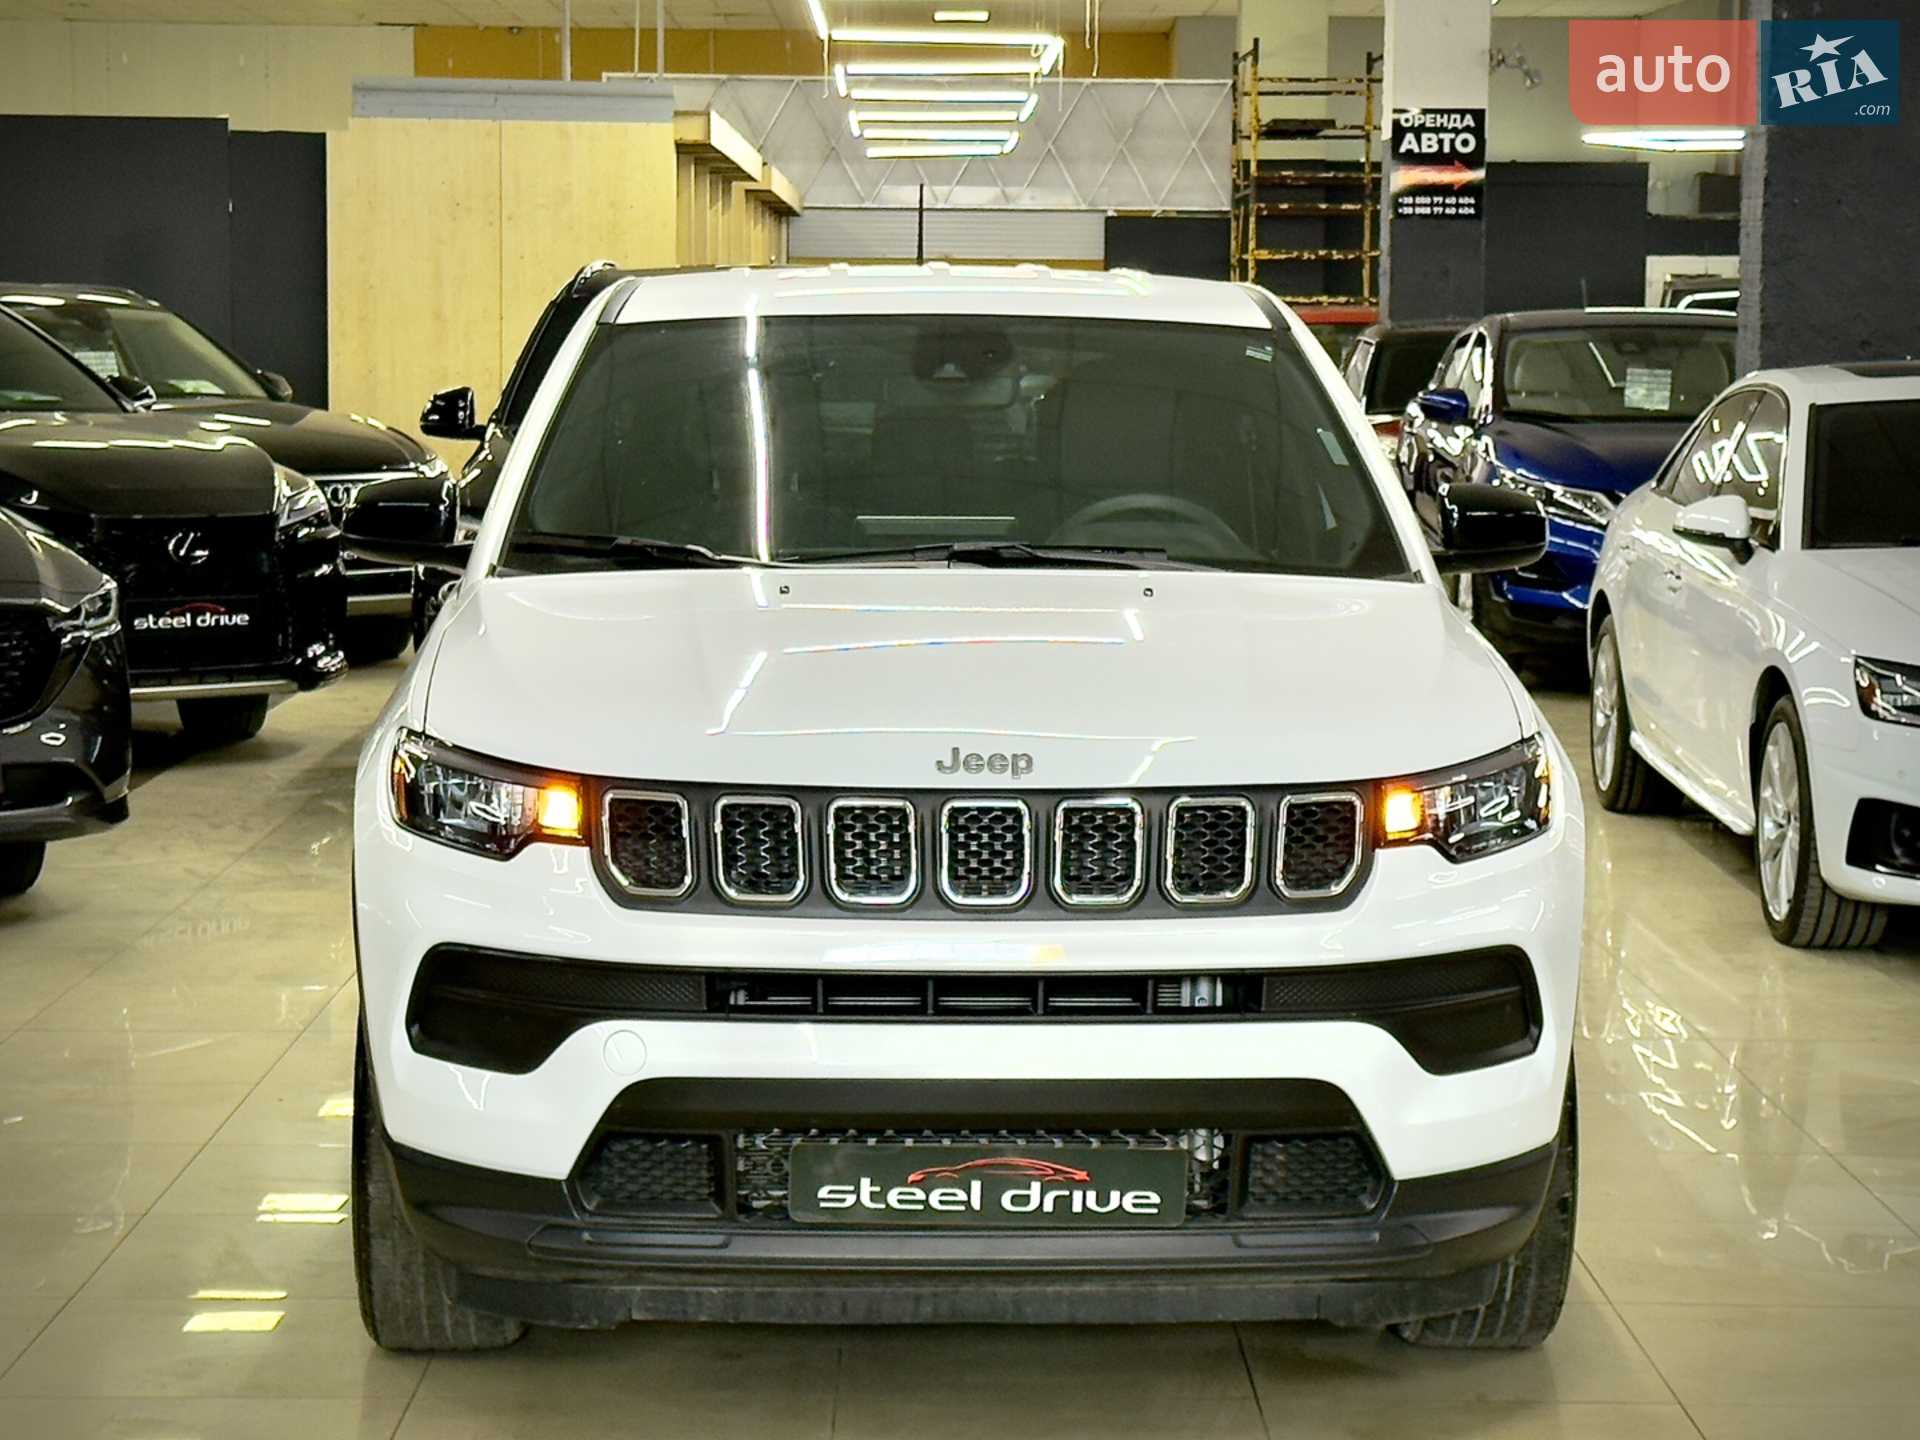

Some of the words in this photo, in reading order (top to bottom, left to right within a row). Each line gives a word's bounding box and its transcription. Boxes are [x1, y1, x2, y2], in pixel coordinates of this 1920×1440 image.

[1400, 113, 1476, 130] ОРЕНДА
[1398, 132, 1477, 154] АВТО
[133, 612, 192, 630] steel
[196, 611, 250, 628] drive
[935, 746, 1034, 780] Jeep
[816, 1177, 982, 1212] steel
[1000, 1181, 1162, 1214] drive
